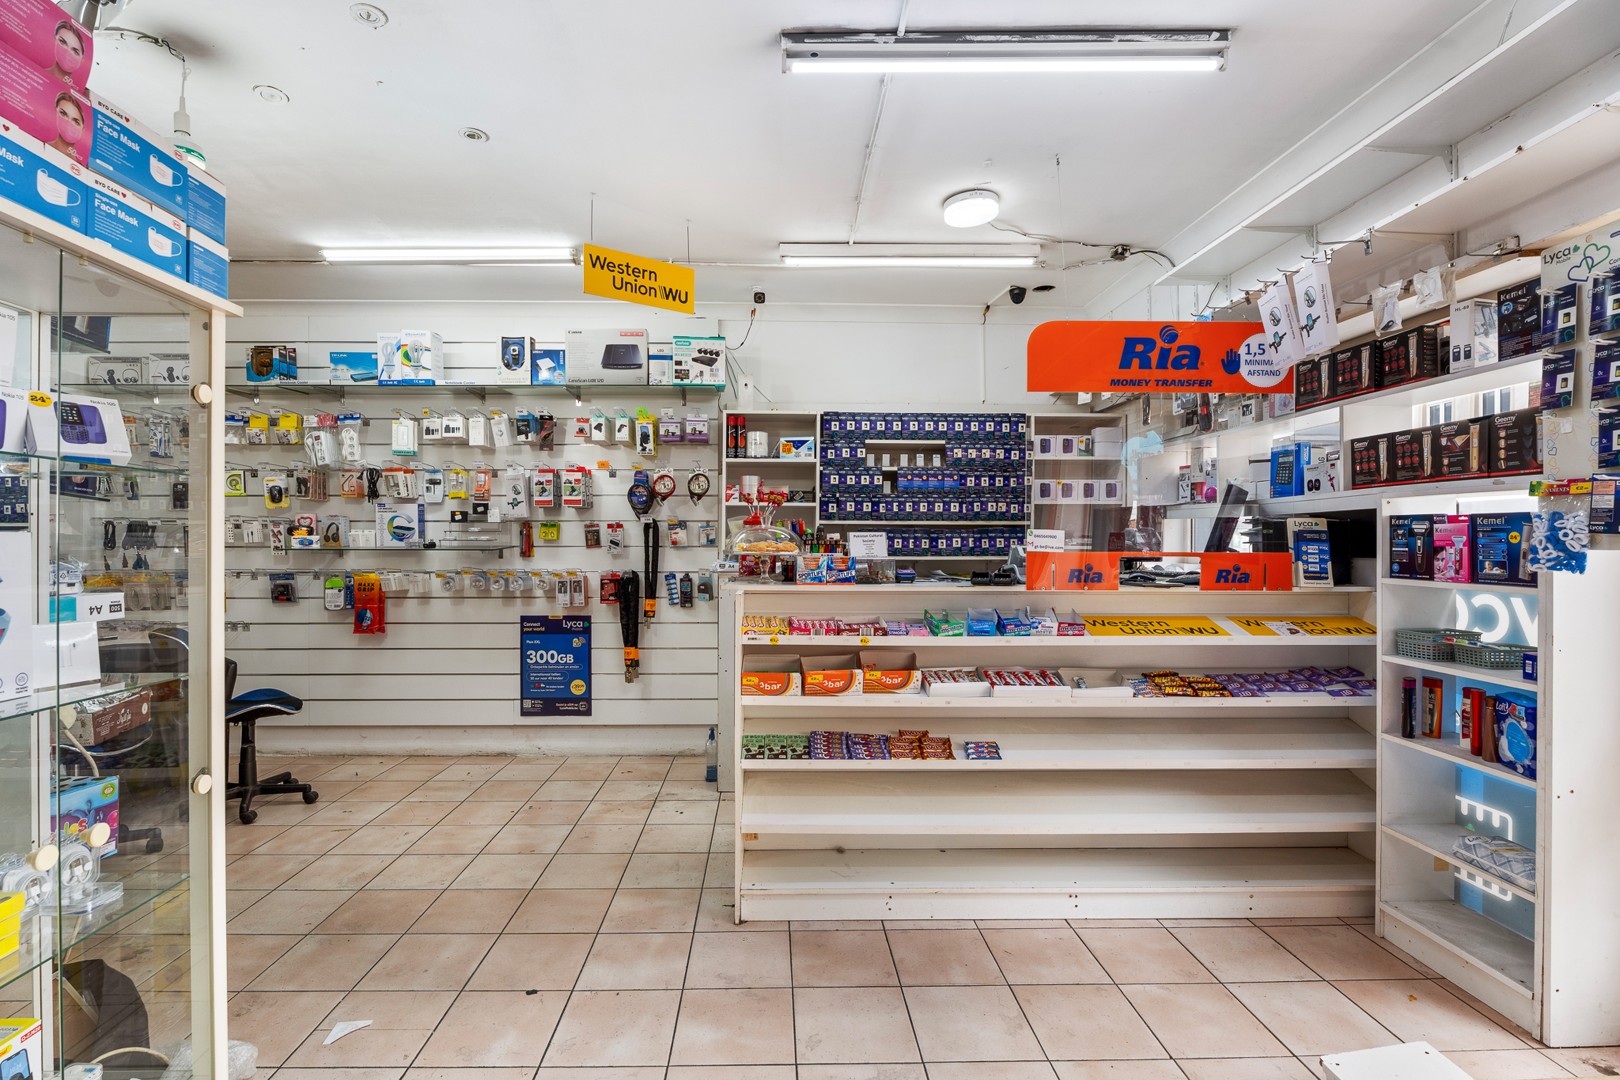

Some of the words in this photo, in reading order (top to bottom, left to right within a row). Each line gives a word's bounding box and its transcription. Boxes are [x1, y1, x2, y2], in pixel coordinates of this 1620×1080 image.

[110, 108, 124, 120] CARE
[97, 120, 119, 138] Face
[120, 133, 140, 152] Mask
[106, 185, 120, 196] CARE
[94, 198, 116, 216] Face
[118, 209, 139, 227] Mask
[1543, 247, 1571, 264] Lyca
[589, 253, 657, 282] Western
[612, 274, 656, 298] Union
[663, 286, 688, 304] WU
[1118, 324, 1202, 370] Ria
[1244, 343, 1266, 358] 1,5
[1247, 369, 1281, 377] AFSTAND
[1110, 378, 1152, 387] MONEY
[1154, 379, 1213, 388] TRANSFER
[1, 391, 16, 399] Nokia
[1494, 415, 1516, 424] Geemy
[1440, 423, 1458, 432] Geemy
[1294, 520, 1314, 528] Lyca
[1590, 524, 1604, 532] Lyca
[798, 570, 824, 580] SPORTLIFE
[828, 570, 856, 580] SPORTLIFE
[1068, 563, 1104, 584] Ria
[1215, 564, 1250, 584] Ria
[89, 604, 103, 615] A4
[562, 620, 583, 629] Lyca
[1238, 620, 1320, 628] Wern
[1121, 626, 1178, 635] Union
[1185, 626, 1218, 635] WU
[526, 650, 574, 664] 300GB
[823, 680, 845, 688] 3bar
[880, 676, 903, 684] 3bar
[759, 682, 782, 690] 3bar
